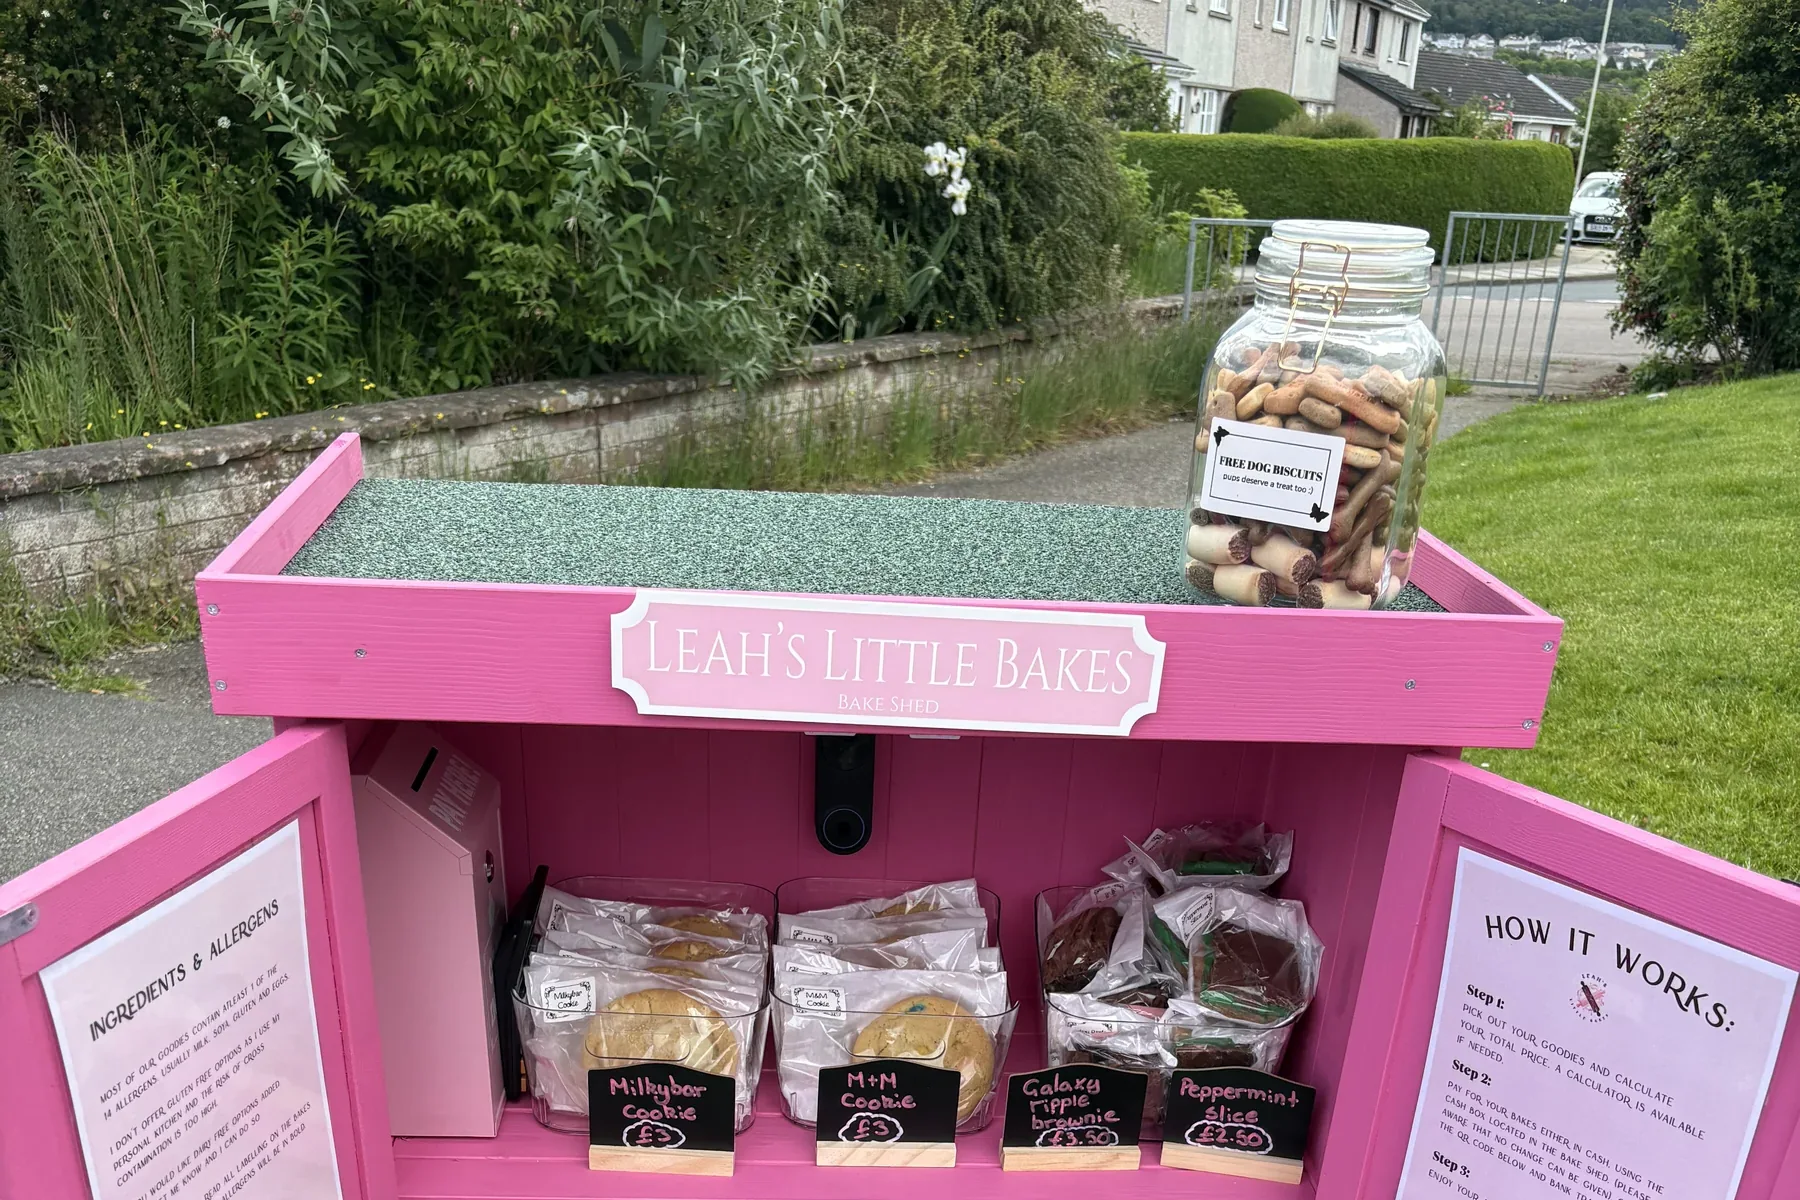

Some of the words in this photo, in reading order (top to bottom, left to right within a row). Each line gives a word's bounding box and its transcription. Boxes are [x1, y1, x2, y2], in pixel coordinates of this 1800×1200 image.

[1220, 456, 1245, 469] FREE
[1248, 461, 1271, 473] DOG
[1273, 465, 1322, 482] BISCUITS
[1223, 474, 1240, 483] pups
[1242, 475, 1268, 487] deserve
[1276, 482, 1293, 491] treat
[1294, 484, 1306, 493] too
[646, 620, 806, 678] LEAH'S
[824, 629, 977, 686] LITTLE
[993, 638, 1133, 694] BAKES
[838, 694, 885, 712] BAKE
[890, 696, 939, 714] SHED
[429, 788, 467, 832] PAY
[90, 964, 186, 1041] INGREDIENTS
[193, 953, 202, 970] &
[210, 899, 279, 960] ALLERGENS
[1485, 915, 1550, 944] HOW
[1569, 928, 1595, 955] IT
[1616, 943, 1734, 1032] WORKS:
[554, 990, 582, 1000] Milkybar
[558, 1000, 579, 1010] Cookie
[806, 992, 828, 1000] M&M
[807, 999, 830, 1008] Cookie
[1466, 984, 1494, 1007] Step
[1497, 998, 1504, 1009] 1:
[99, 1081, 121, 1103] MOST
[124, 1071, 134, 1085] OF
[138, 1057, 157, 1074] OUR
[157, 1031, 189, 1060] GOODIES
[191, 1008, 220, 1035] CONTAIN
[222, 986, 247, 1012] ATLEAST
[255, 974, 263, 986] OF
[267, 963, 277, 978] THE
[1456, 1034, 1464, 1043] IF
[1462, 1003, 1482, 1019] PICK
[1487, 1014, 1507, 1029] OUT
[1511, 1025, 1537, 1047] YOUR
[1540, 1039, 1584, 1066] GOODIES
[1589, 1062, 1610, 1076] AND
[1614, 1073, 1674, 1106] CALCULATE
[848, 1071, 897, 1089] M+M
[1452, 1059, 1478, 1080] Step
[1481, 1073, 1492, 1086] 2:
[1460, 1019, 1485, 1040] YOUR
[1489, 1032, 1515, 1052] TOTAL
[1554, 1064, 1561, 1073] A
[1566, 1069, 1632, 1109] CALCULATOR
[1635, 1100, 1645, 1112] IS
[1650, 1108, 1705, 1140] AVAILABLE
[610, 1075, 707, 1105] Milkybar
[1023, 1074, 1100, 1096] Galaxy
[1180, 1077, 1299, 1108] Peppermint
[112, 1136, 151, 1171] PERSONAL
[153, 1109, 182, 1138] KITCHEN
[184, 1097, 198, 1113] AND
[200, 1084, 213, 1099] THE
[215, 1070, 230, 1088] RISK
[232, 1060, 240, 1073] OF
[243, 1042, 264, 1064] CROSS
[1030, 1094, 1090, 1113] ripple
[853, 1120, 889, 1139] £3
[1032, 1109, 1120, 1130] brownie
[223, 1170, 235, 1185] ALL
[235, 1139, 267, 1172] LABELLING
[269, 1129, 279, 1142] ON
[280, 1117, 291, 1132] THE
[292, 1101, 310, 1121] BAKES
[636, 1126, 671, 1144] £3
[1048, 1129, 1110, 1146] £3.50
[1197, 1128, 1262, 1148] £2.50
[1445, 1094, 1466, 1110] CASH
[1468, 1106, 1485, 1120] BOX
[1488, 1116, 1525, 1139] LOCATED
[1528, 1136, 1537, 1146] IN
[1541, 1142, 1557, 1156] THE
[1559, 1152, 1582, 1169] BAKE
[1433, 1151, 1457, 1173] Step
[1460, 1165, 1470, 1178] 3:
[1428, 1168, 1453, 1187] ENJOY
